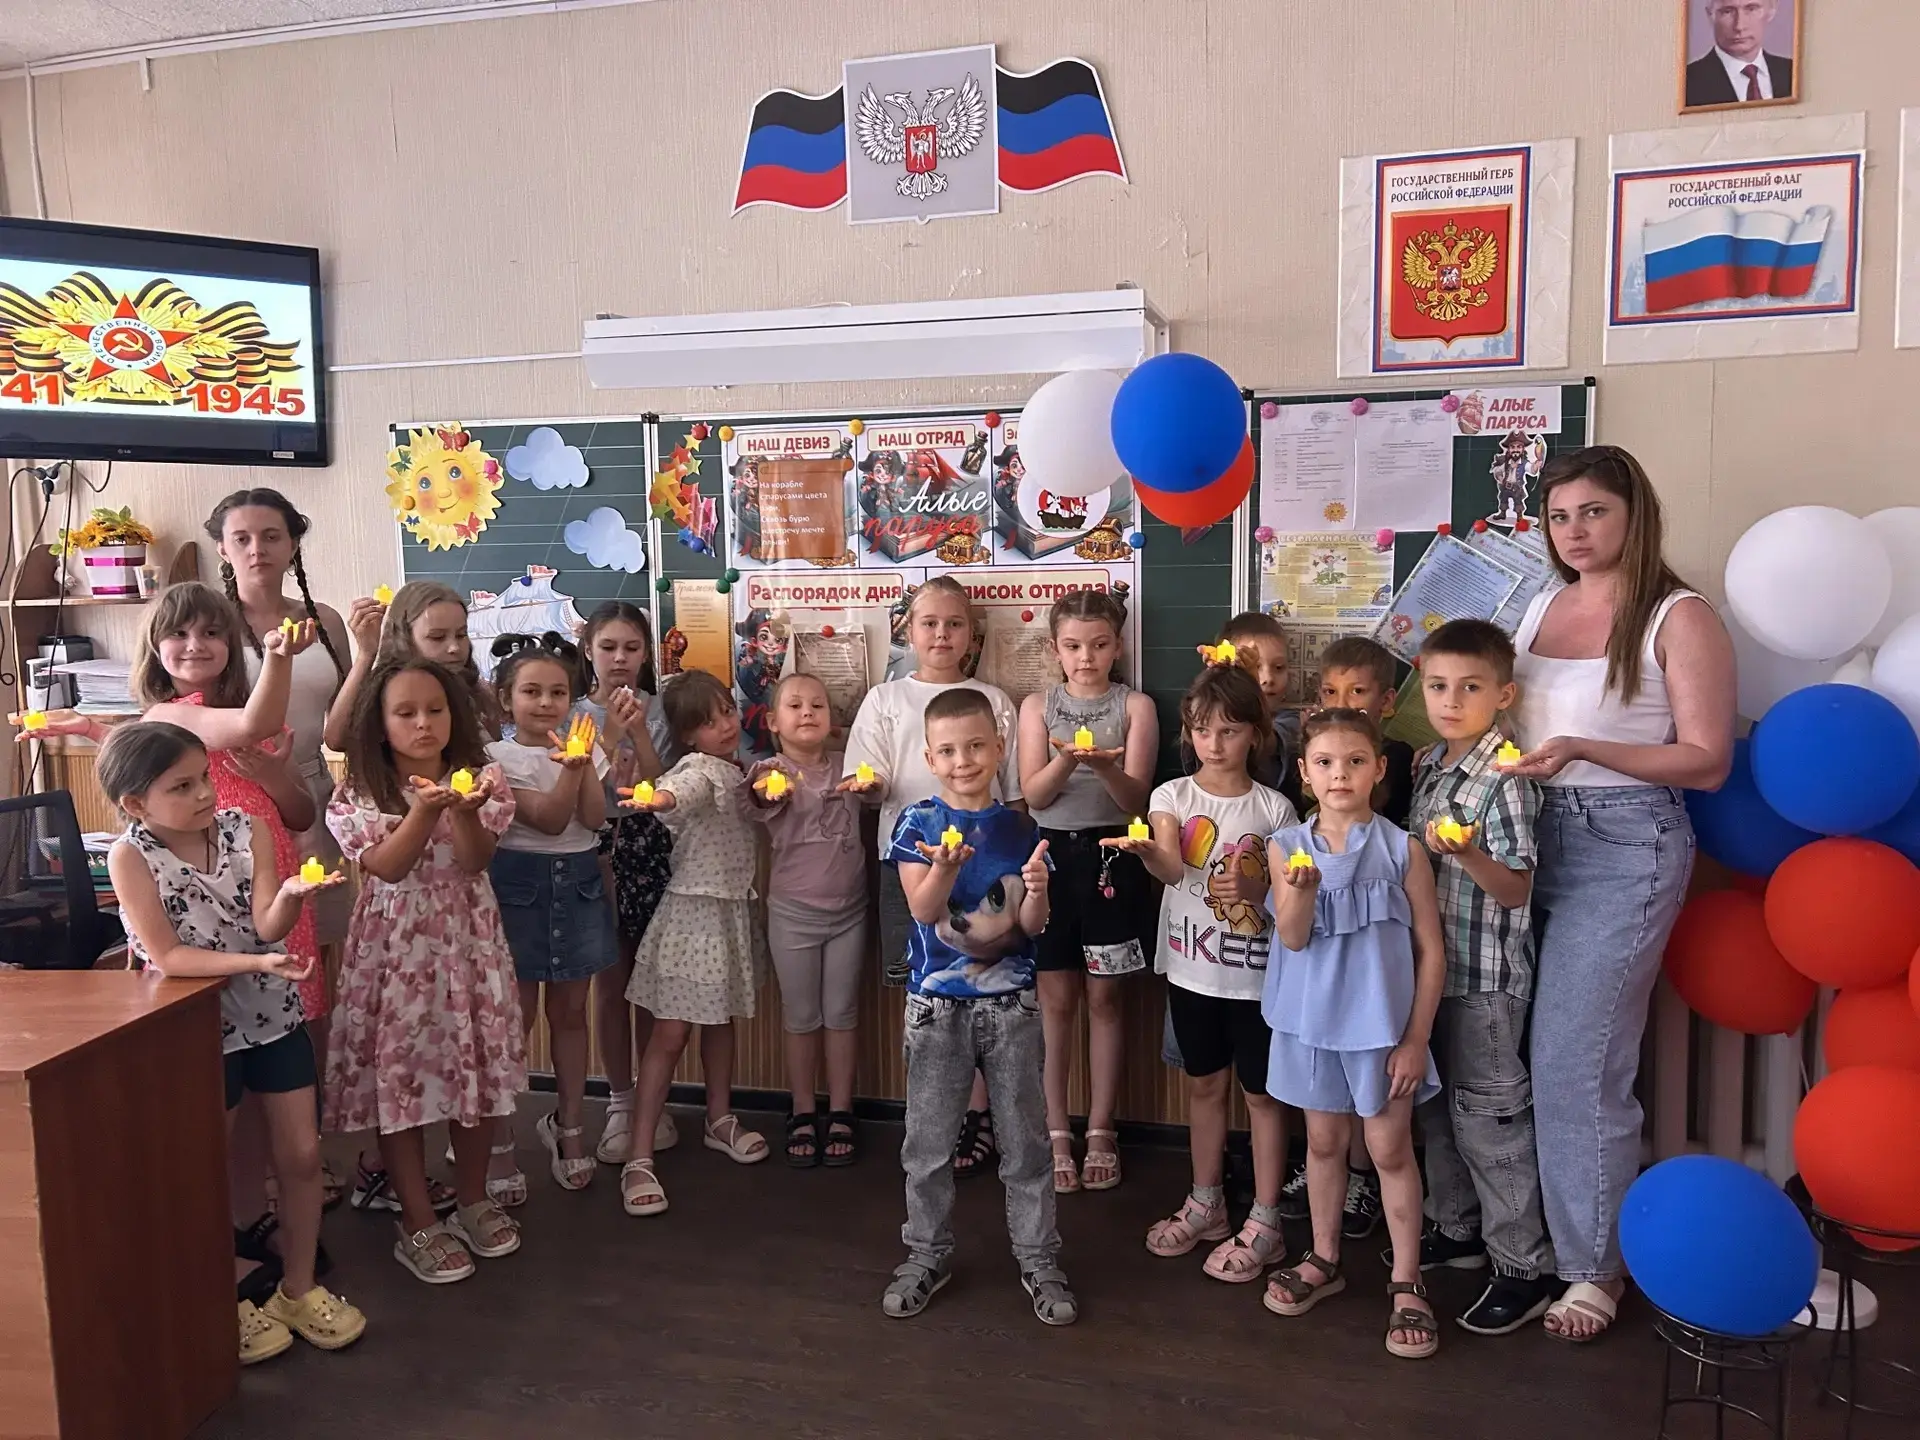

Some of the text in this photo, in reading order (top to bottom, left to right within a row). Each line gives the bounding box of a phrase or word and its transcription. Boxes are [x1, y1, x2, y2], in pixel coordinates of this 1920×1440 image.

[1391, 167, 1514, 188] ГОСУДАРСТВЕННЫЙ ГЕРБ
[1669, 172, 1802, 193] ГОСУДАРСТВЕННЫЙ ФЛАГ
[1390, 184, 1514, 203] РОССИЙСКОЙ ФЕДЕРАЦИИ
[1668, 188, 1803, 208] РОССИЙСКОЙ ФЕДЕРАЦИИ
[92, 320, 157, 365] ОТЕЧЕСТВЕННАЯ
[0, 373, 61, 406] 41
[186, 382, 306, 416] 1945
[1488, 397, 1536, 412] АЛЫЕ
[1485, 414, 1548, 430] ПАРУСА
[747, 436, 831, 453] НАШ ДЕВИЗ
[878, 430, 966, 447] НАШ ОТРЯД
[760, 480, 804, 490] На корабле
[898, 475, 988, 513] Алые
[804, 491, 828, 500] цвета
[788, 514, 810, 524] бурю
[800, 526, 826, 534] мечте
[864, 513, 983, 552] паруса
[750, 584, 902, 604] Распорядок дня
[962, 583, 1024, 600] писок
